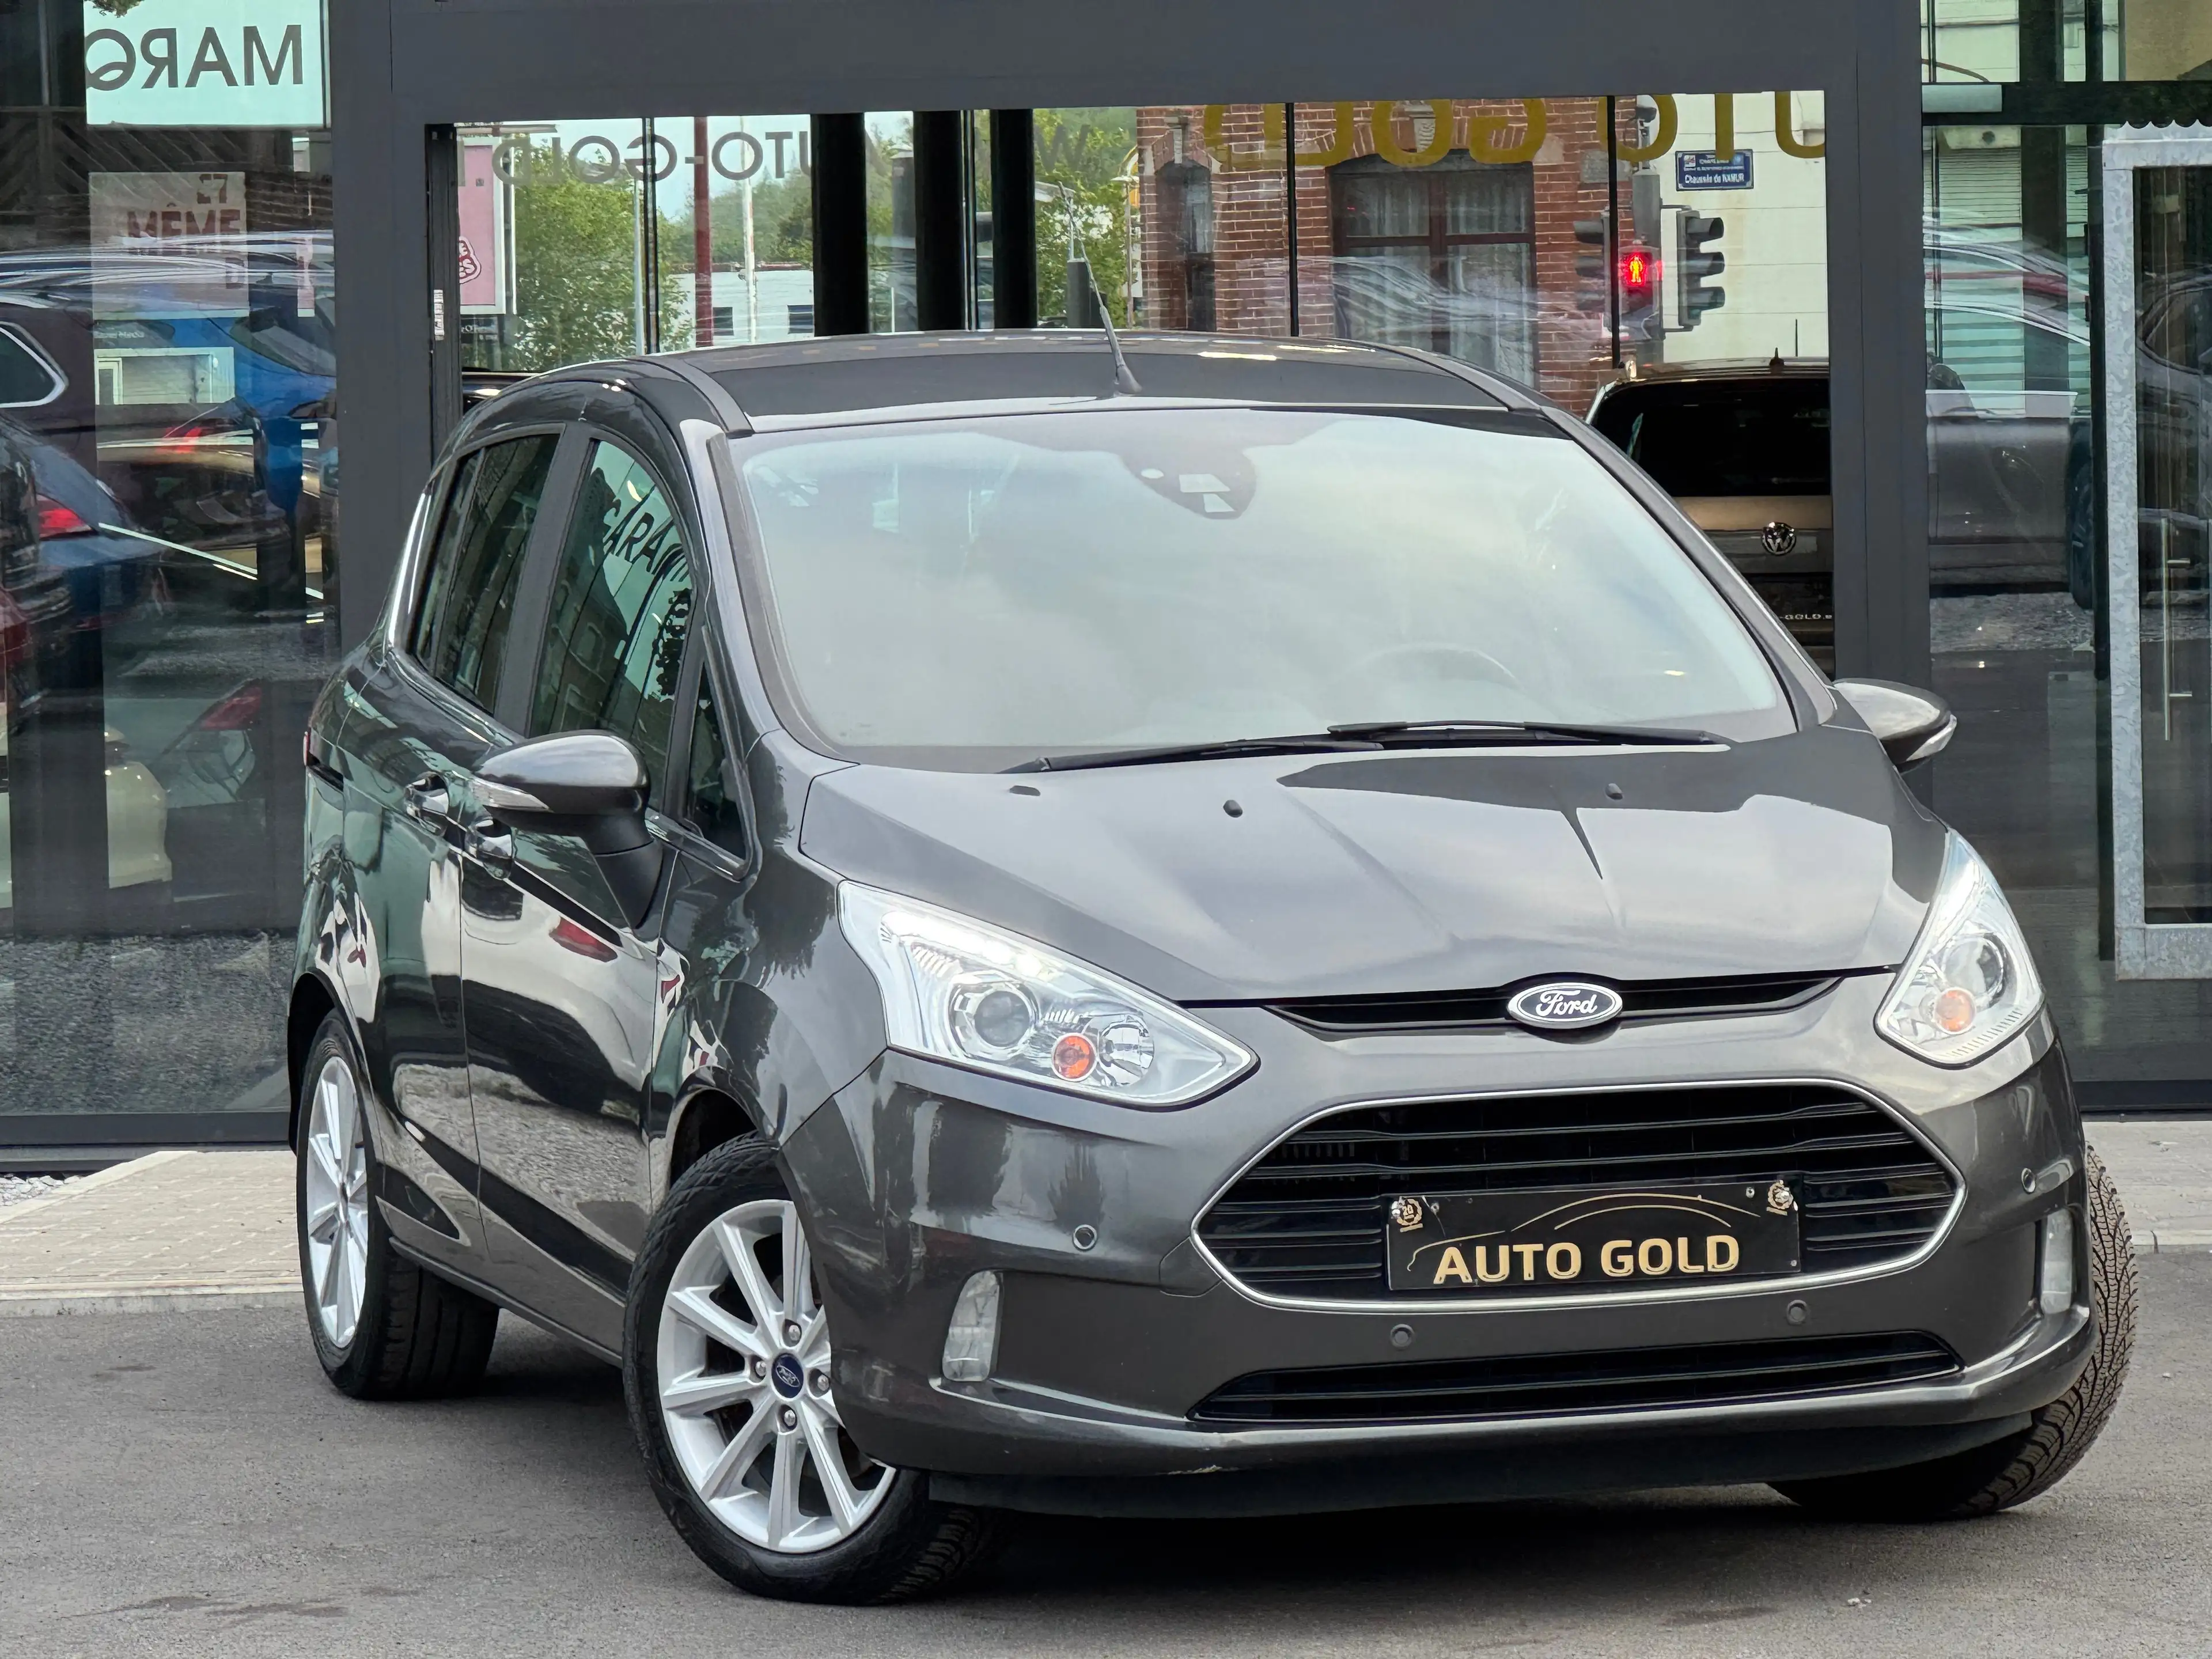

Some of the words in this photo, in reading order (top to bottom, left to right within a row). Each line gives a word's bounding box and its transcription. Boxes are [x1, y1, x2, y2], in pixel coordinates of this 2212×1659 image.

[1535, 990, 1598, 1017] Ford
[1433, 1242, 1582, 1285] AUTO
[1601, 1234, 1740, 1277] GOLD
